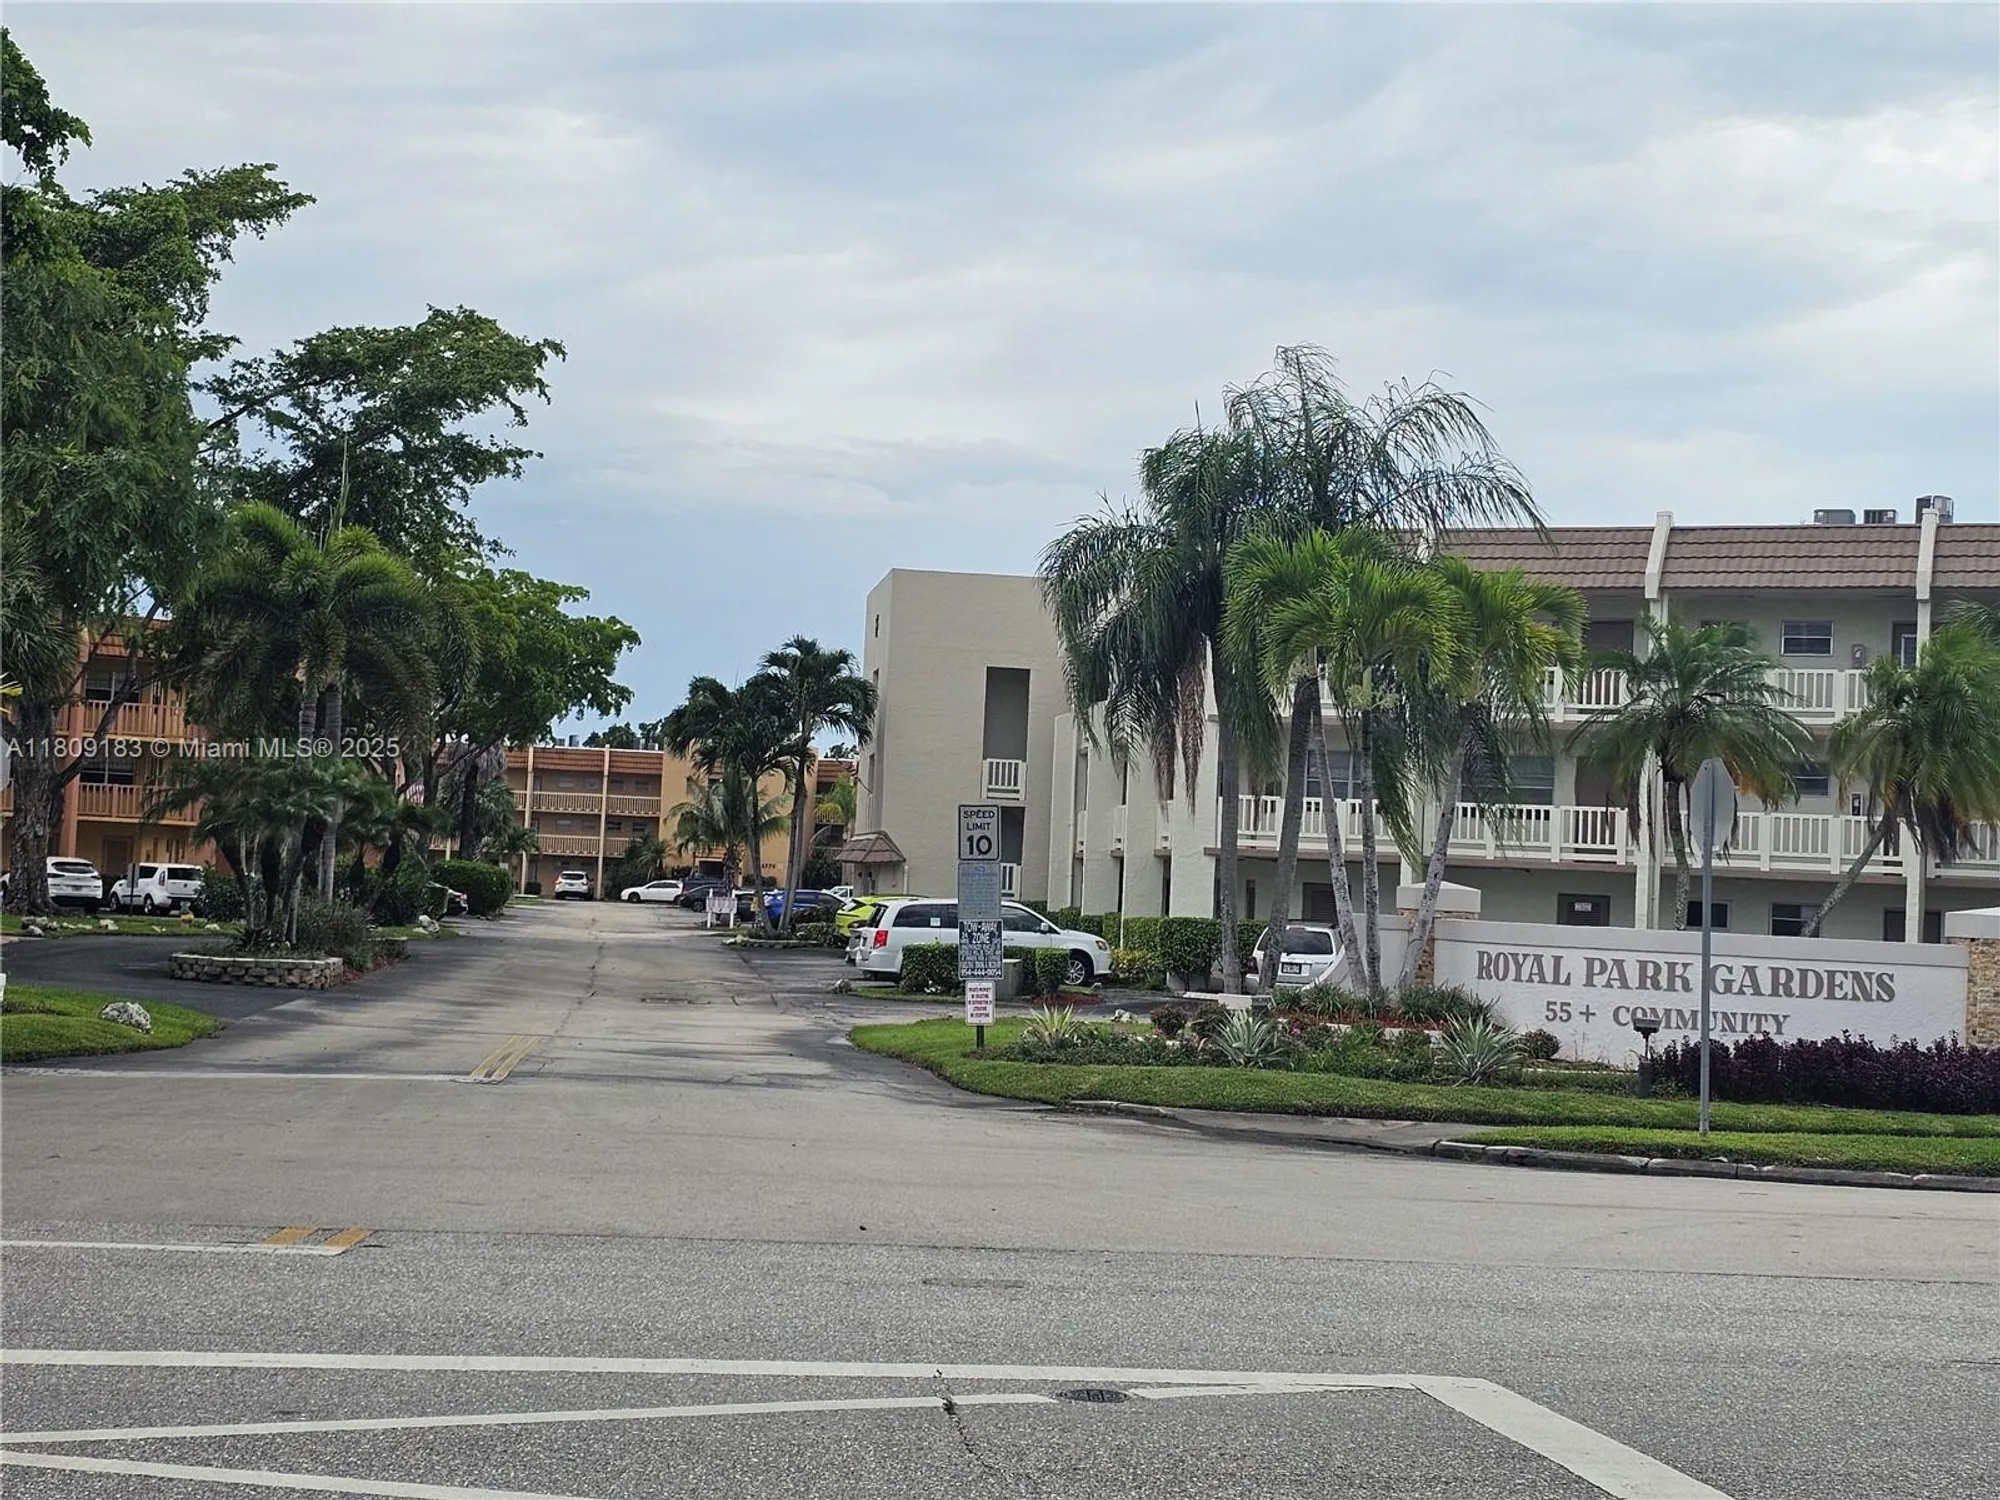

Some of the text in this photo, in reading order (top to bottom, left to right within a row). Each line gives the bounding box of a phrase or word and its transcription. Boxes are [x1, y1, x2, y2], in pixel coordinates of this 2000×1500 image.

[963, 810, 995, 819] SPEED
[966, 823, 991, 831] LIMIT
[967, 835, 992, 855] 10
[972, 932, 990, 944] ZONE
[1477, 950, 1896, 1002] ROYAL PARK GARDENS
